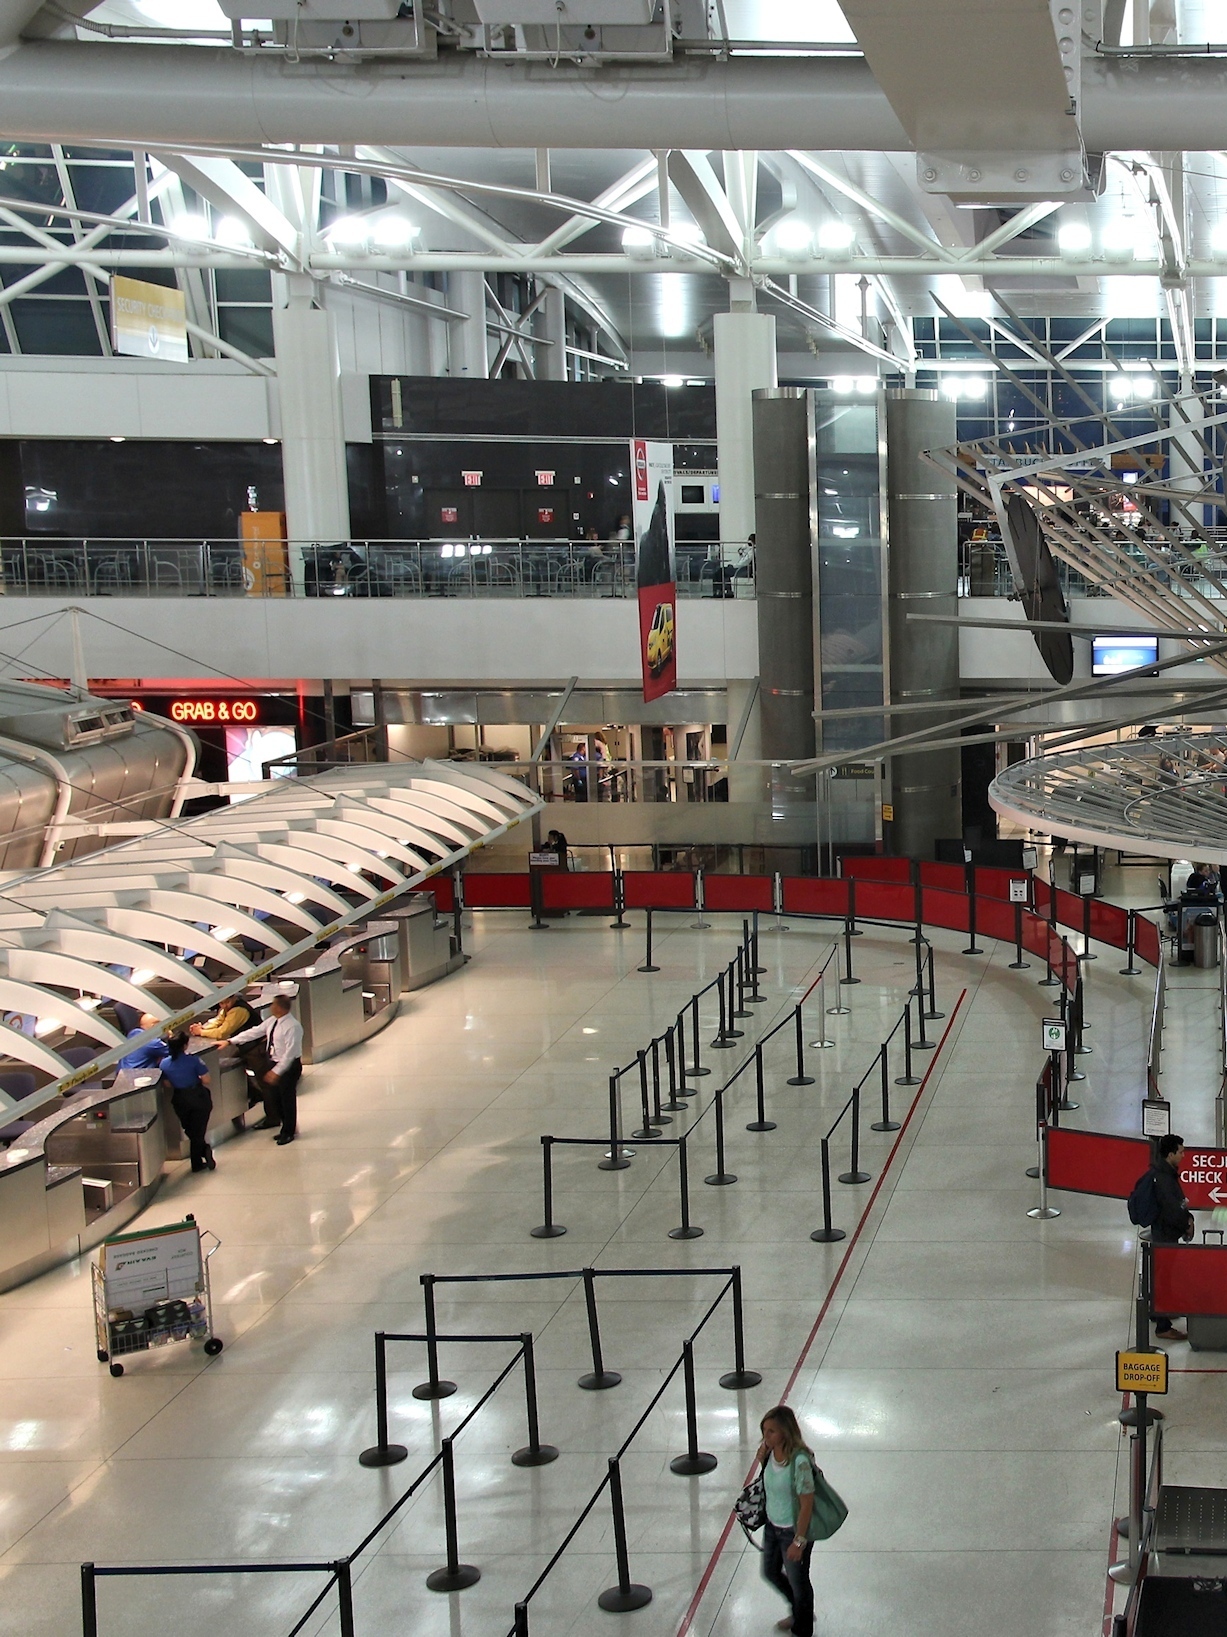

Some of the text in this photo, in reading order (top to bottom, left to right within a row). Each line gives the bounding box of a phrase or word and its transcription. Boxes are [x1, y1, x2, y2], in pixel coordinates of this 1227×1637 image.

[467, 474, 480, 486] EXIT
[540, 474, 553, 486] EXIT
[171, 701, 257, 720] GRAB & GO
[1180, 1170, 1223, 1184] CHECK
[1123, 1363, 1161, 1372] BAGGAGE
[1123, 1373, 1161, 1382] DROP-OFF
